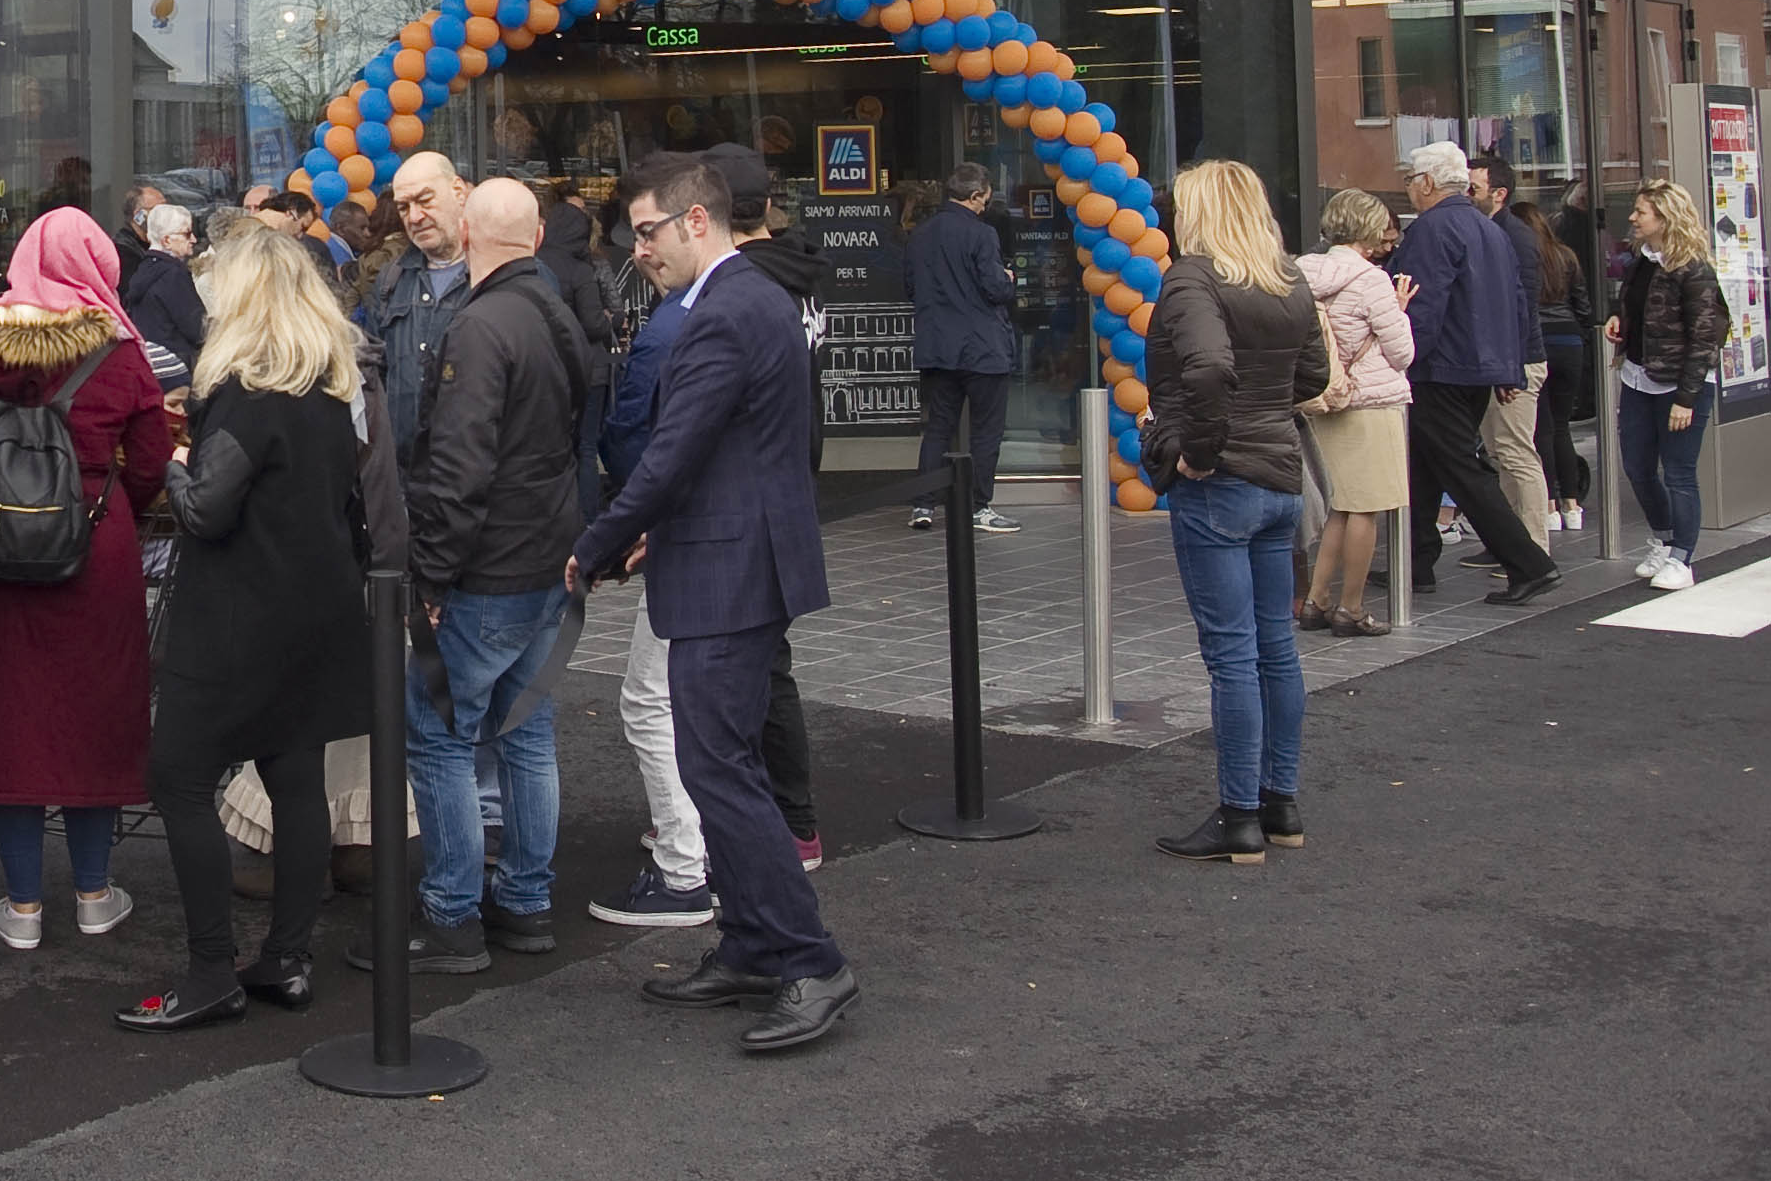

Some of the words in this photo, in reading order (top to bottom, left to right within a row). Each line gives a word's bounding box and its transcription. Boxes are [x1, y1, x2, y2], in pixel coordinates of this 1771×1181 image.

[646, 26, 699, 46] Cassa
[828, 167, 866, 180] ALDI
[805, 206, 835, 217] SIAMO
[838, 205, 880, 217] ARRIVATI
[883, 205, 892, 217] A
[823, 231, 879, 247] NOVARA
[836, 268, 854, 279] PER
[856, 268, 868, 279] TE
